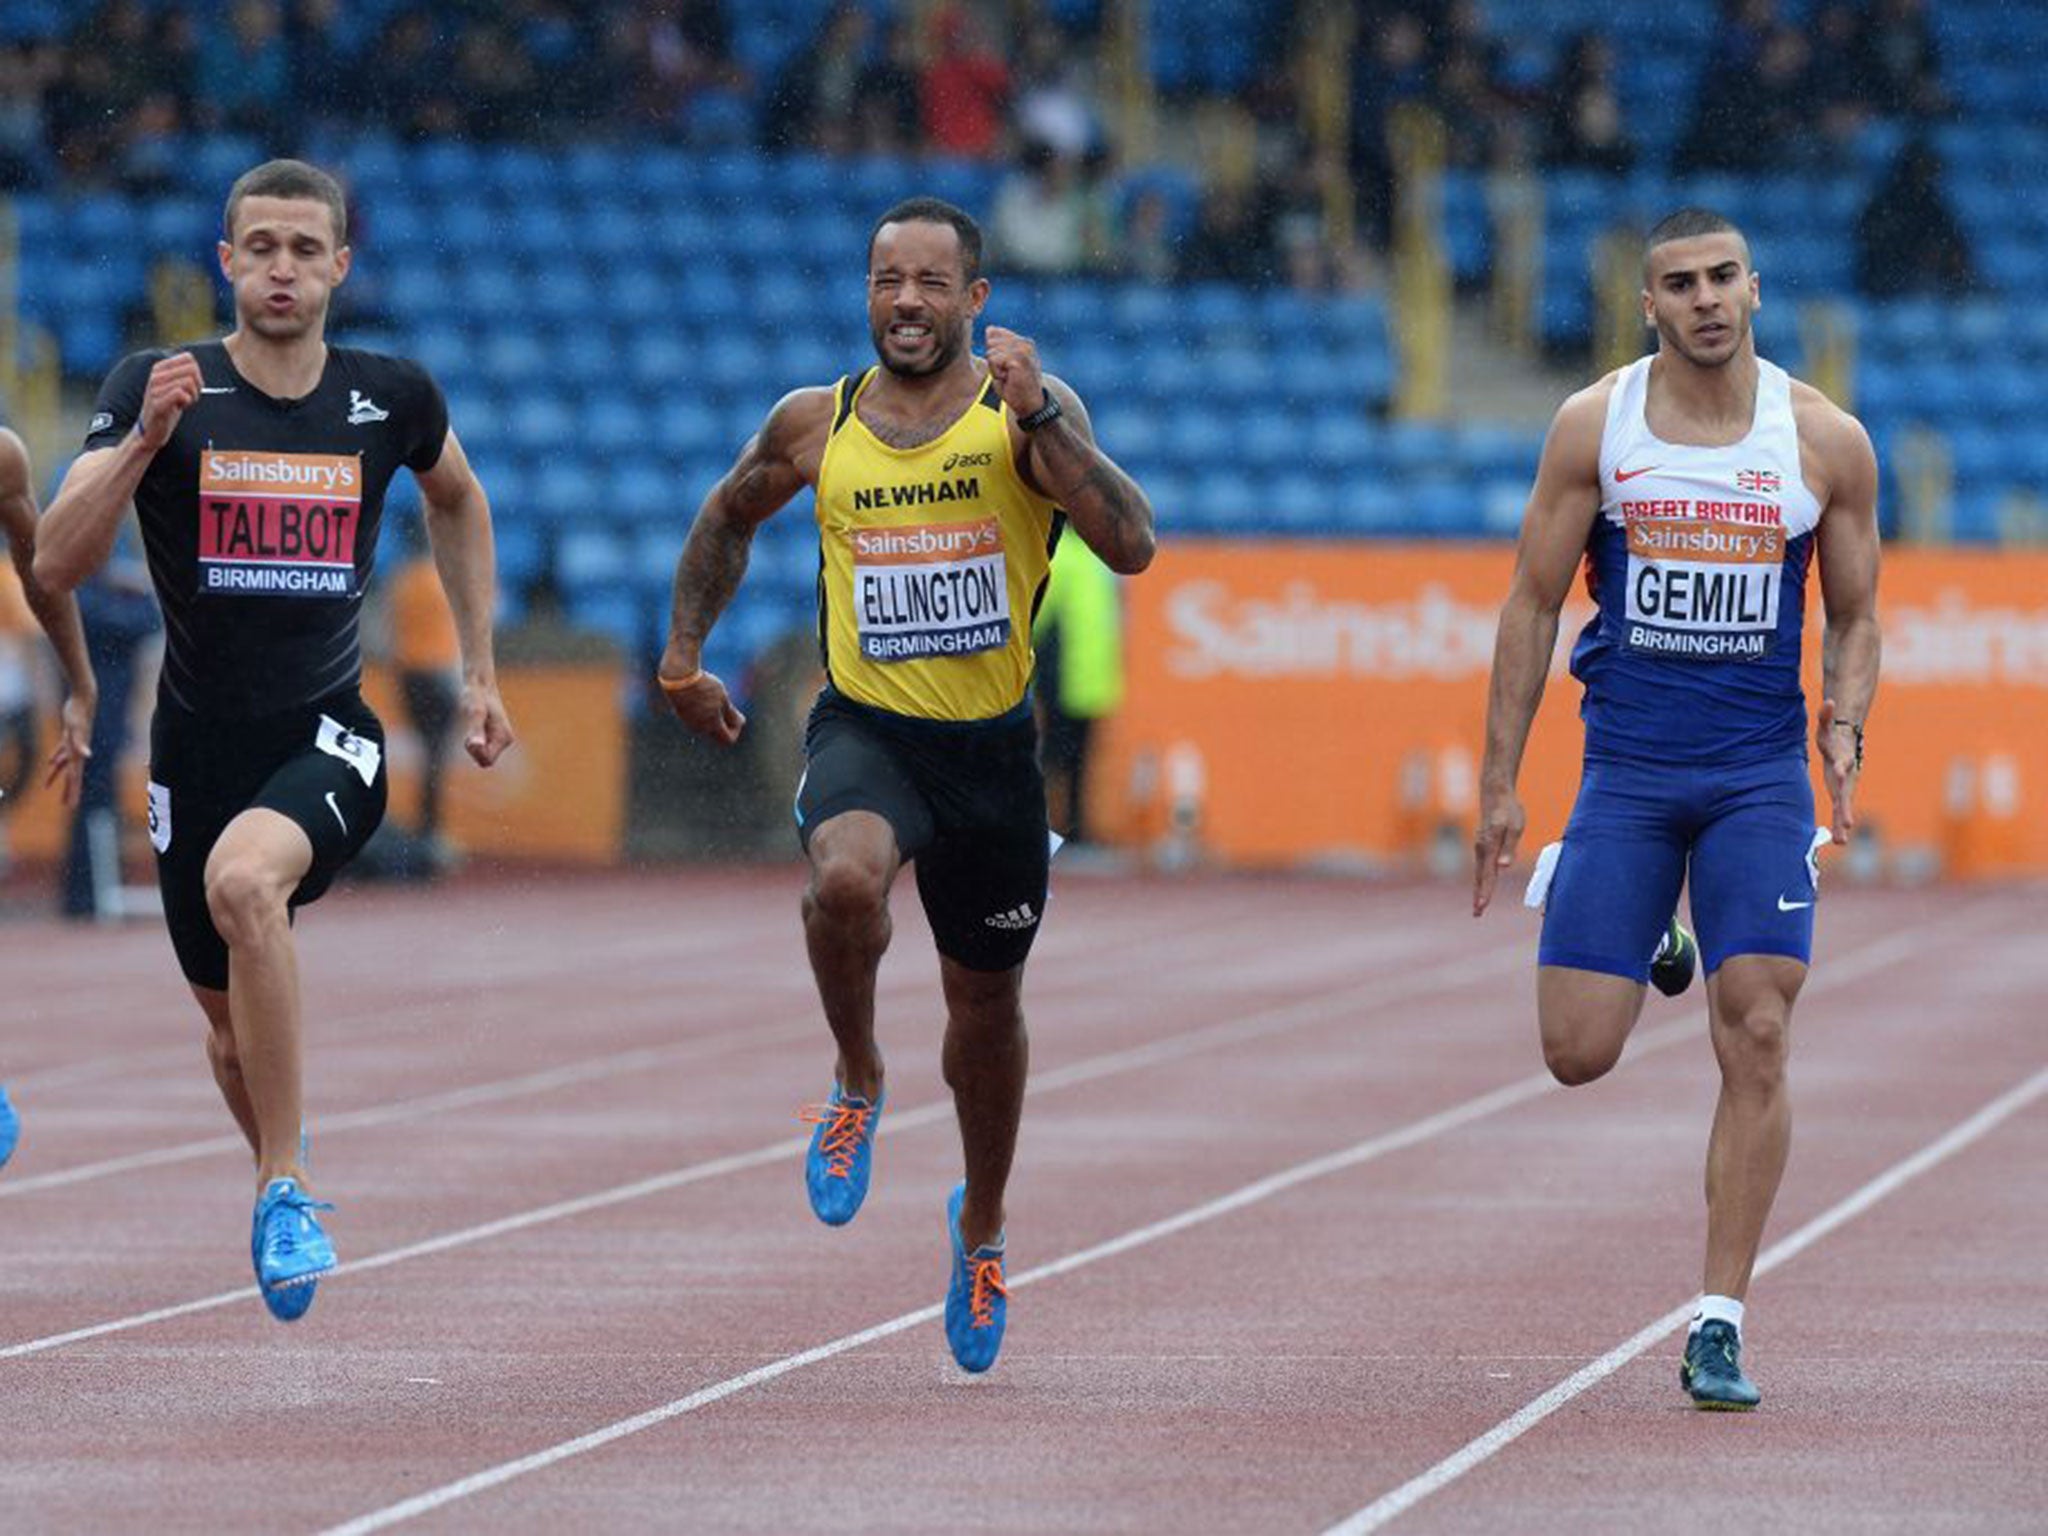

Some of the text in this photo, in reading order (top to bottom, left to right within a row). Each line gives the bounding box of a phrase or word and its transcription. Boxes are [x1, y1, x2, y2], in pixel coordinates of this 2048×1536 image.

[208, 456, 355, 490] Sainsbury's
[854, 478, 980, 510] NEWHAM
[1621, 500, 1781, 525] GREAT BRITAIN
[209, 502, 351, 559] TALBOT
[856, 523, 998, 554] Sainsbury's
[1634, 523, 1778, 557] Sainsbury's
[207, 567, 348, 592] BIRMINGHAM
[863, 564, 999, 626] ELLINGTON
[1636, 565, 1771, 623] GEMILI
[868, 626, 1001, 656] BIRMINGHAM
[1630, 626, 1766, 655] BIRMINGHAM
